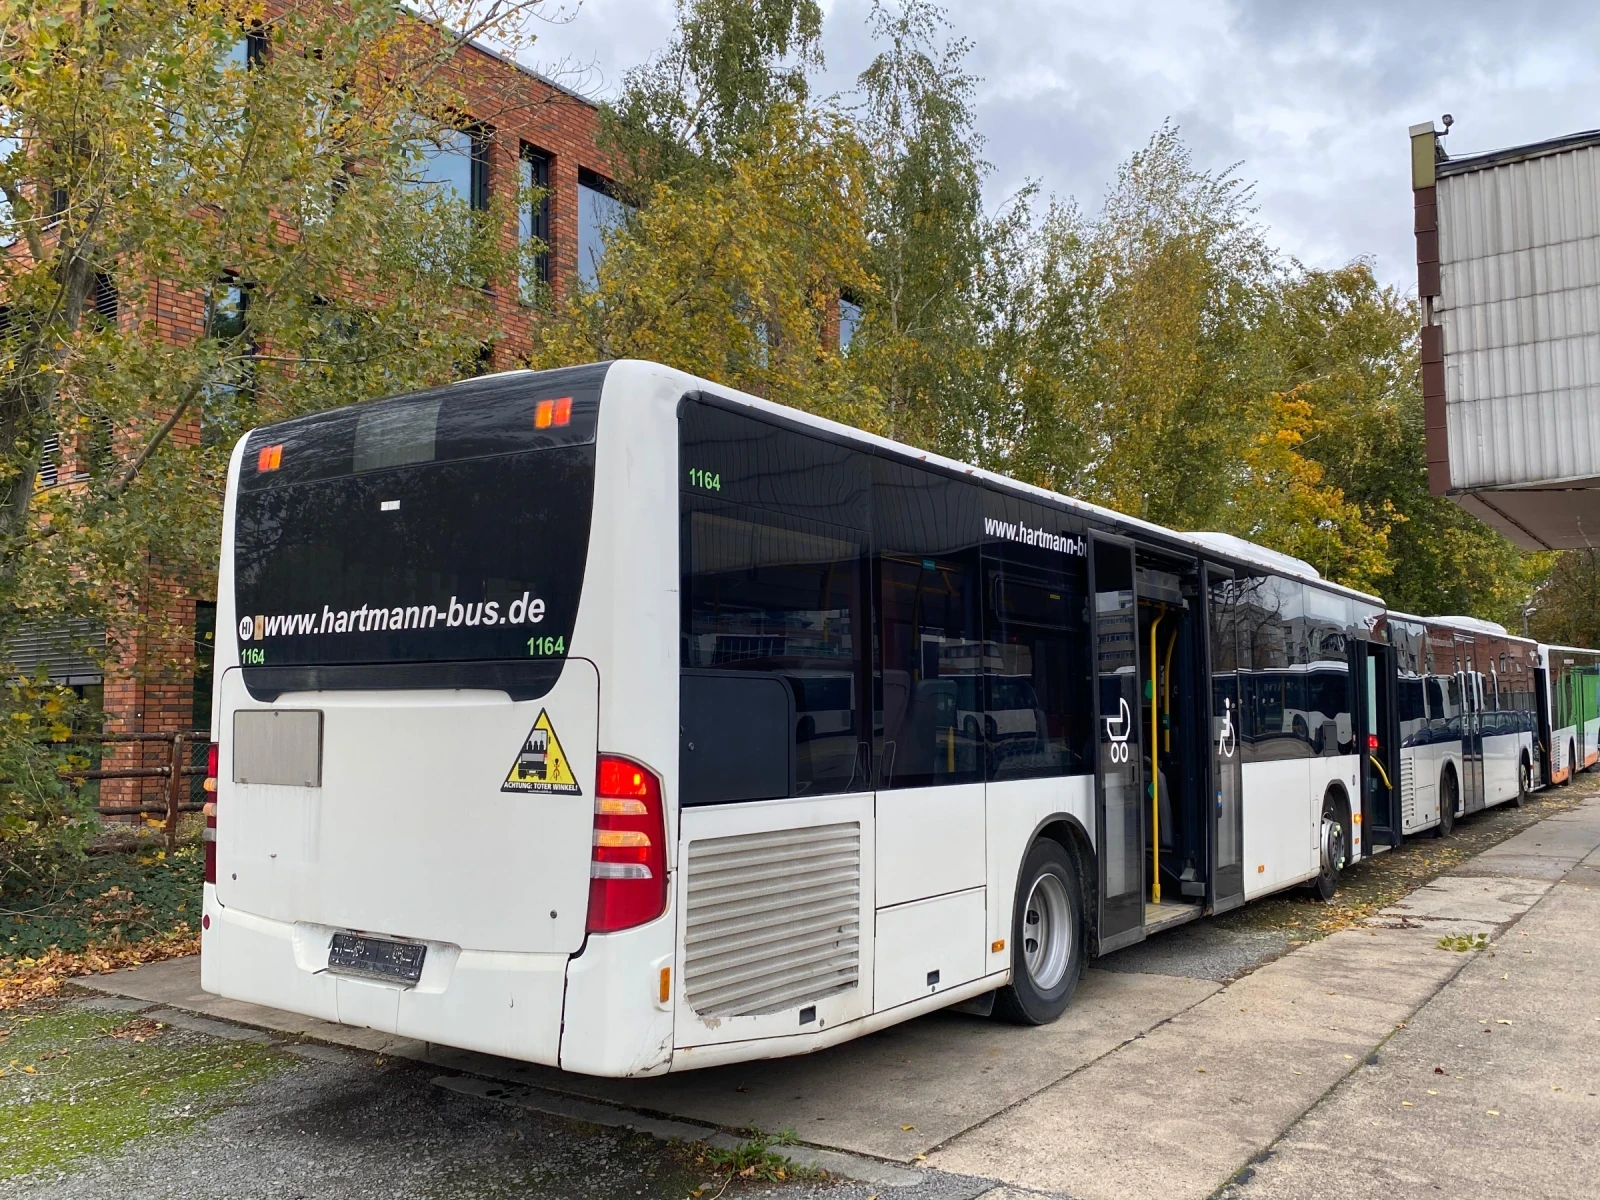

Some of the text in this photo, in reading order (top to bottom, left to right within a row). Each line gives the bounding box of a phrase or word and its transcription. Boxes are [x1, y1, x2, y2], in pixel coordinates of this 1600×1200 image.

[689, 468, 720, 491] 1164
[265, 592, 545, 636] www.hartmann-bus.de
[241, 648, 264, 664] 1164
[527, 636, 564, 655] 1164
